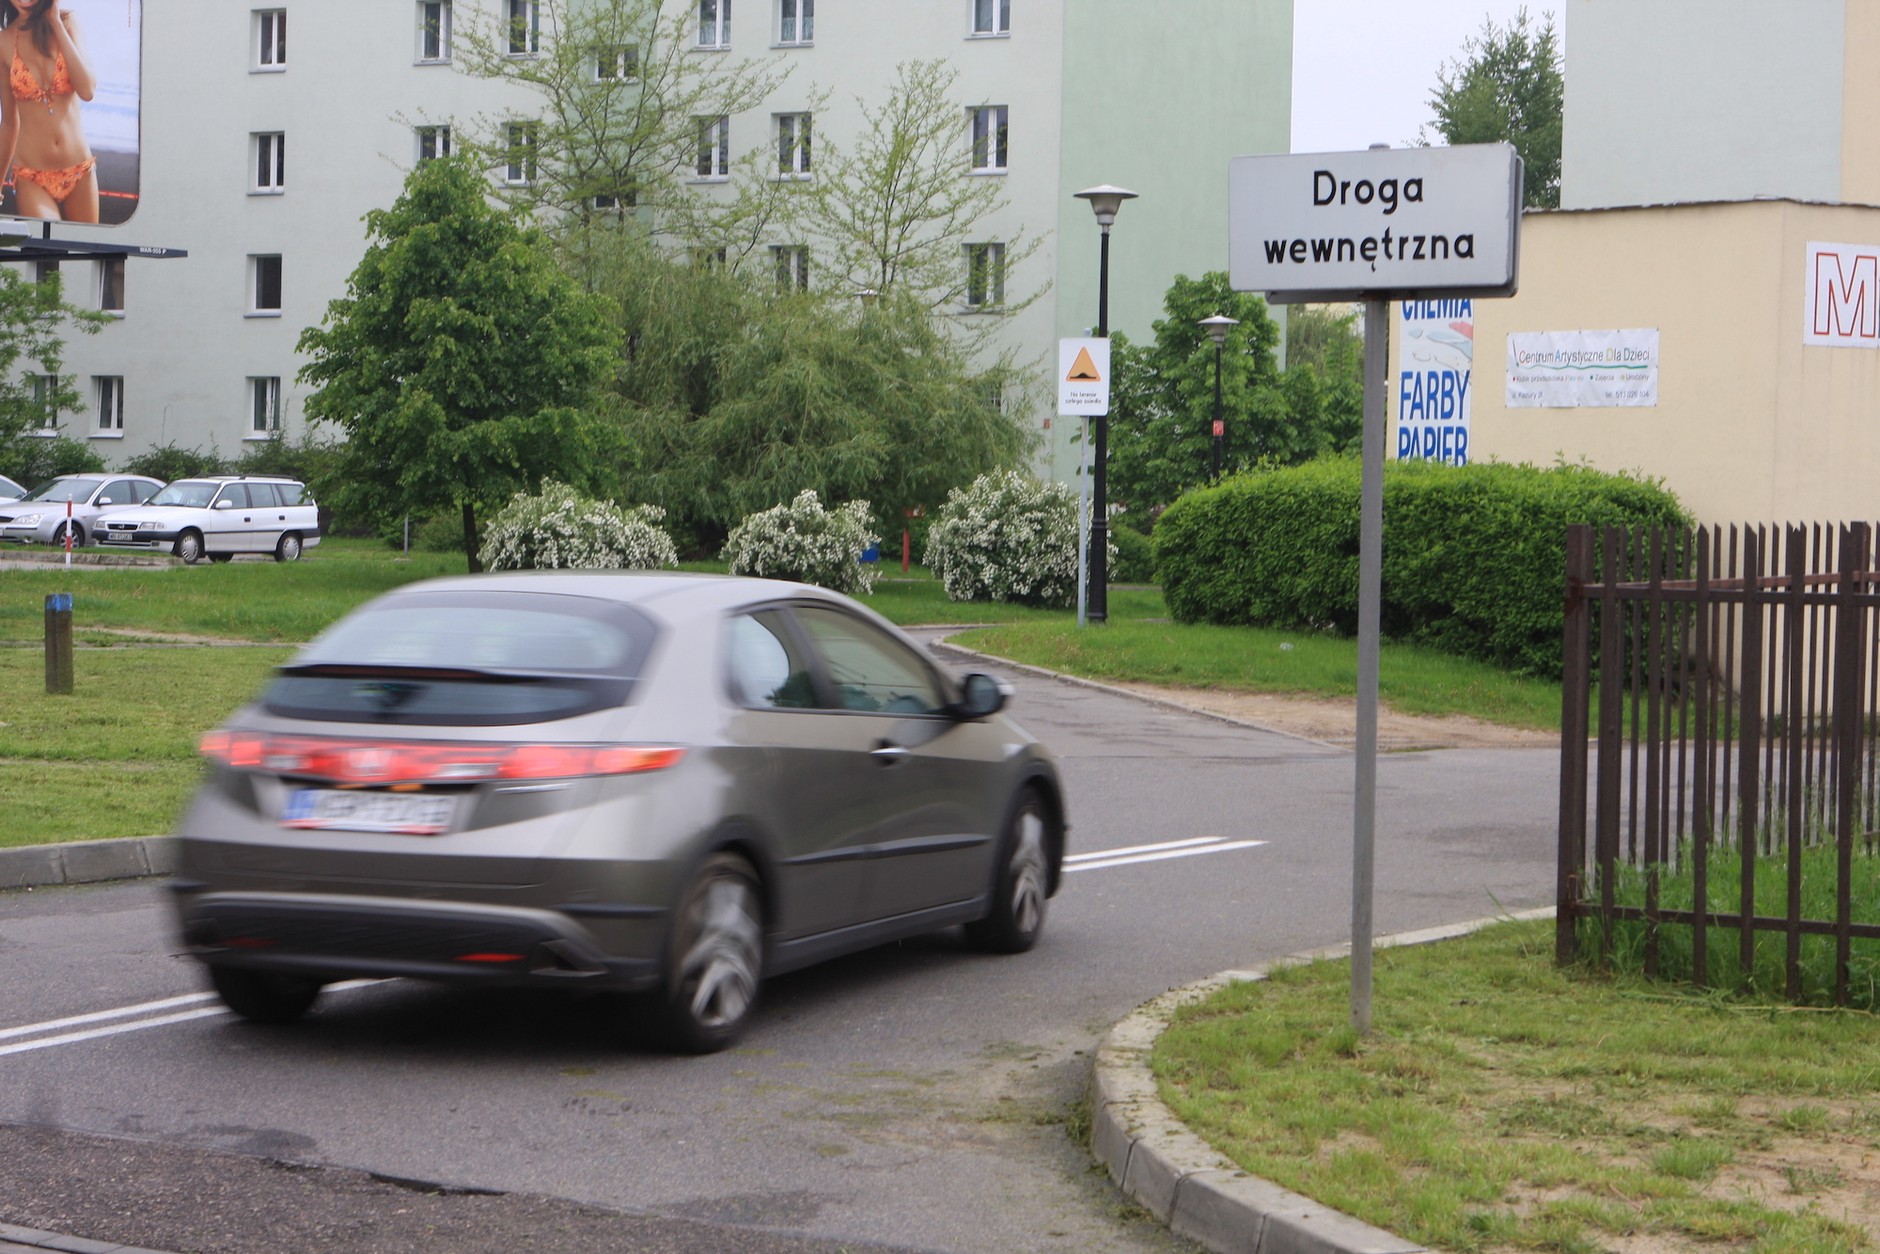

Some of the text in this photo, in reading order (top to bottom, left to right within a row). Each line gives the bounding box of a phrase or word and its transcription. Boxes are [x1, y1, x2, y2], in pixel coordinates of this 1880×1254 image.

[1313, 170, 1423, 215] Droga
[1264, 226, 1474, 272] wewnętrzna
[1518, 346, 1650, 366] Centrum Artystyczne Dla Dzieci
[1399, 369, 1471, 420] FARBY
[1397, 426, 1468, 466] PAPIER
